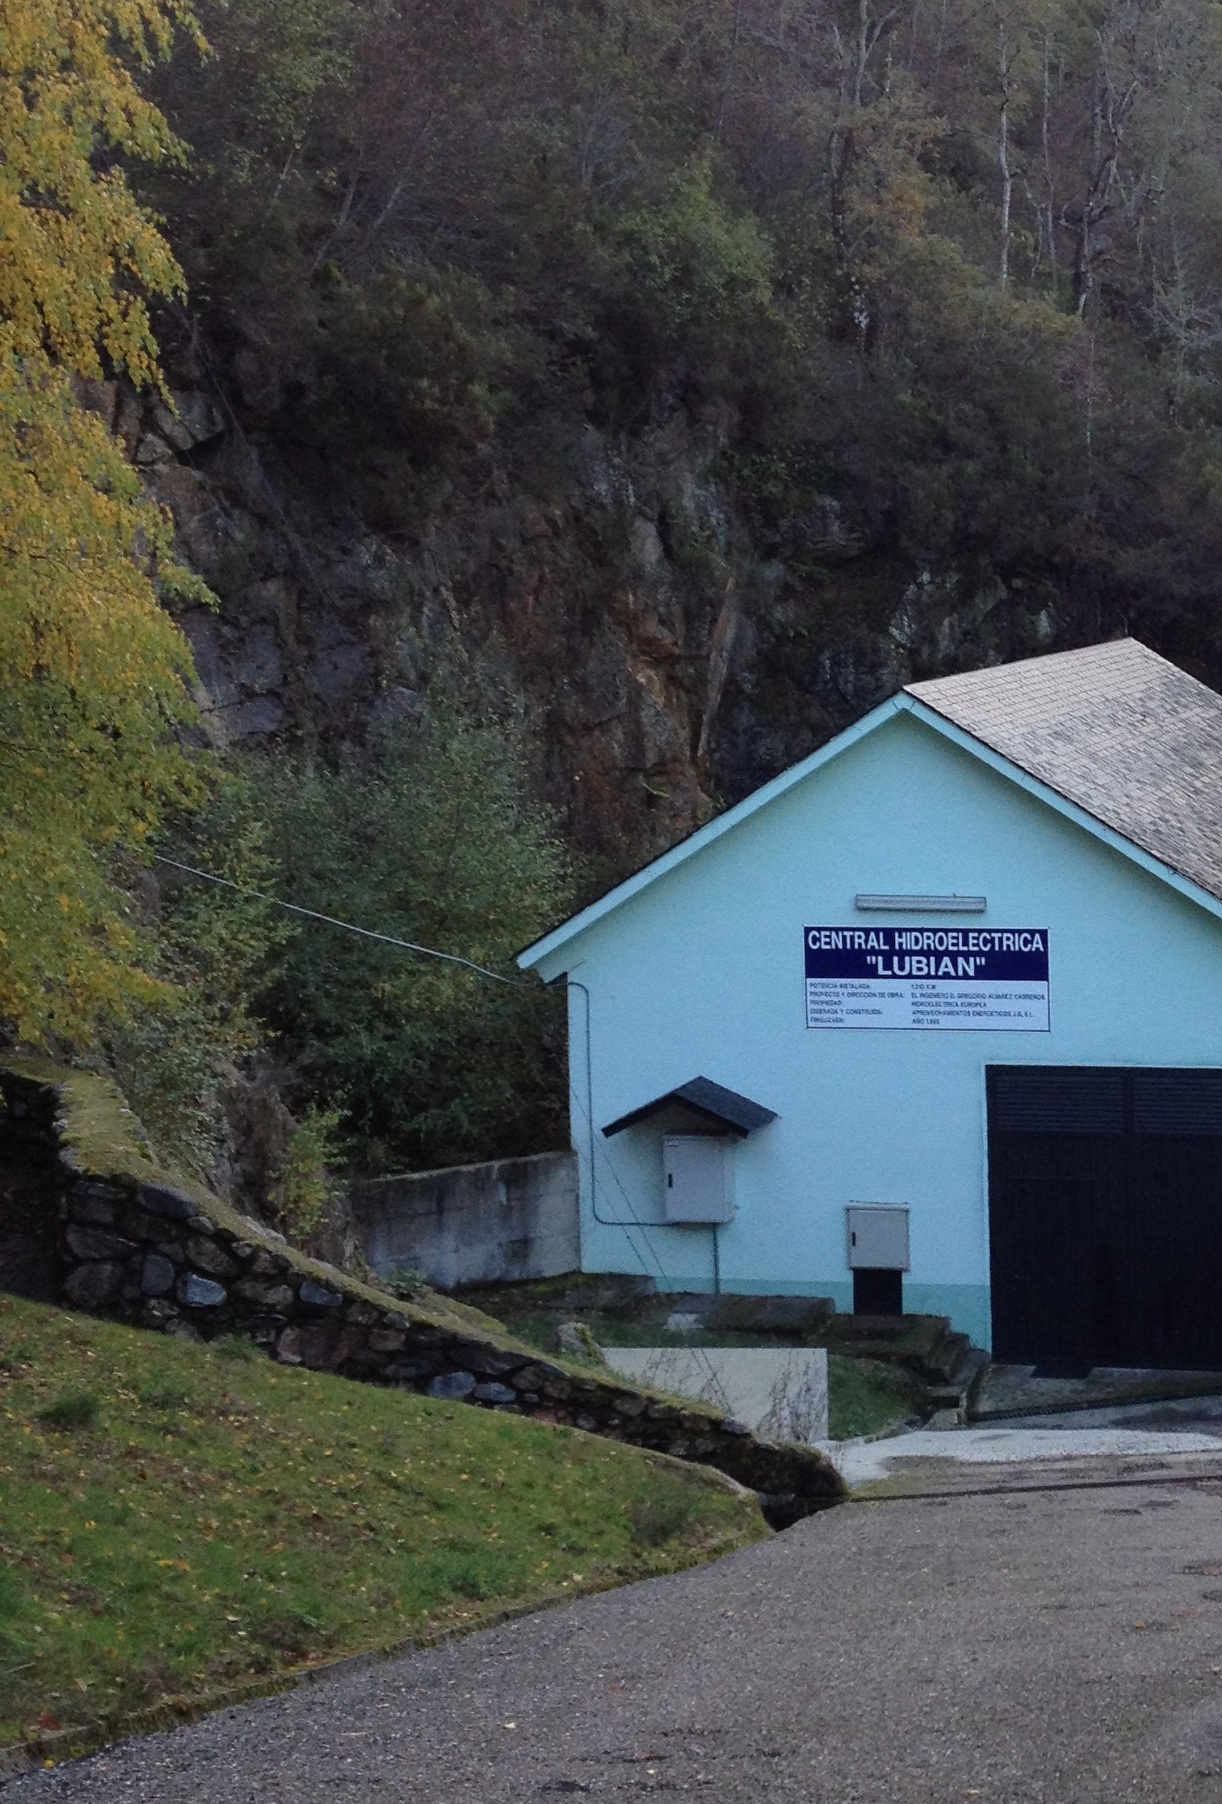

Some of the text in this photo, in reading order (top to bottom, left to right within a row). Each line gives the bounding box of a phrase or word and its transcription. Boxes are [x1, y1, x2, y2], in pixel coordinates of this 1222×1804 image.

[808, 930, 1044, 952] CENTRAL HIDROELECTRICA
[866, 955, 986, 977] "LUBIAN"
